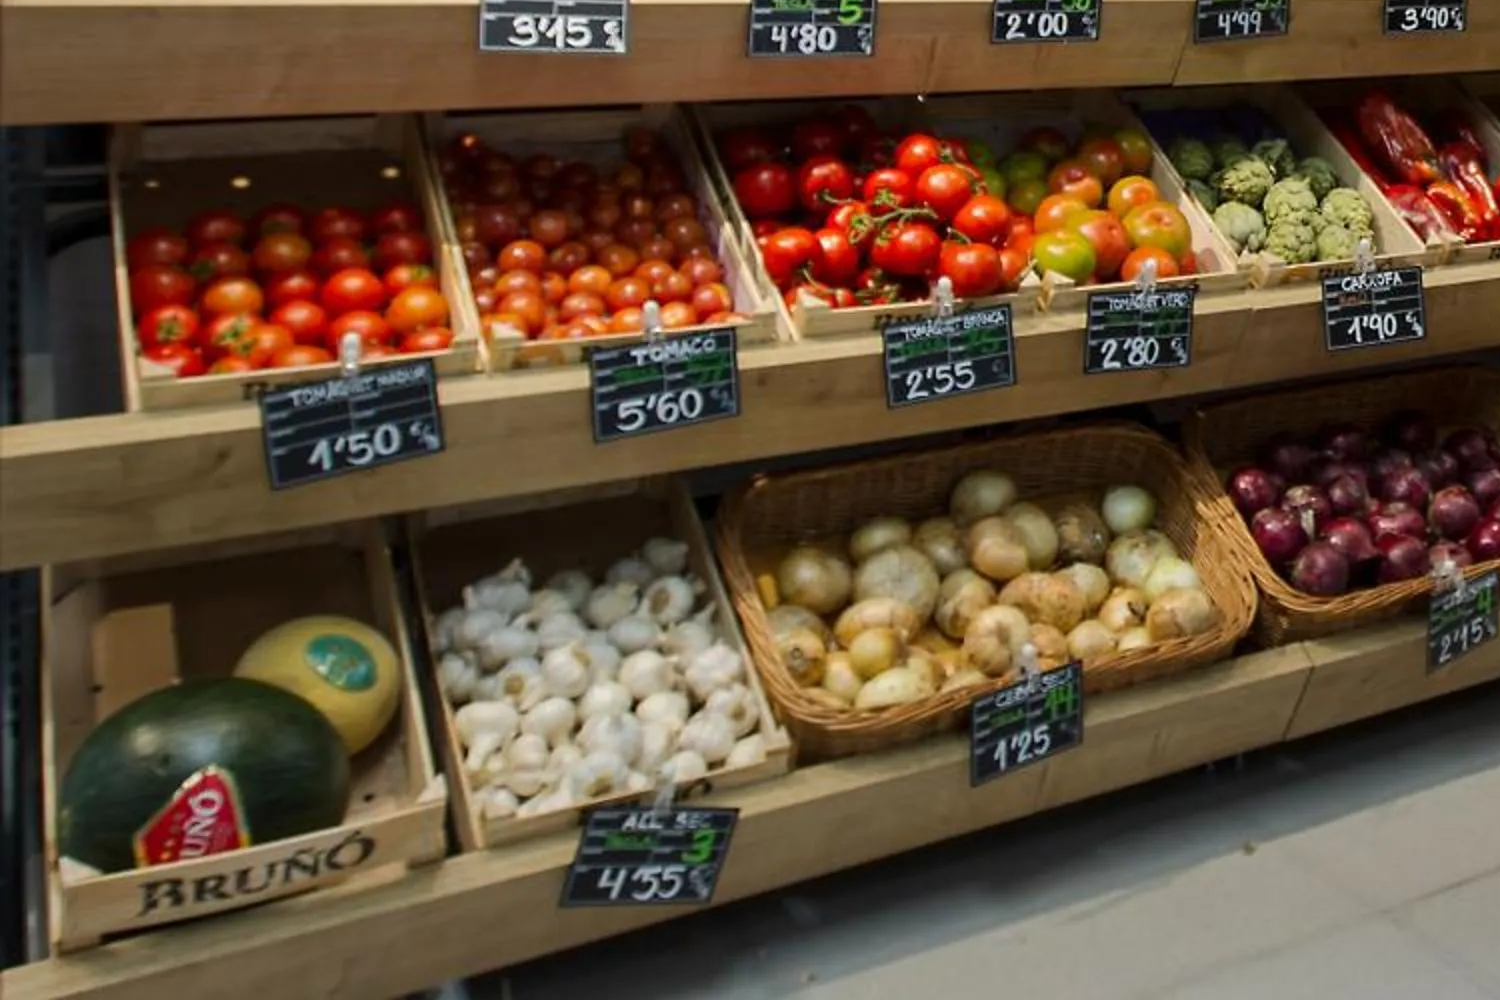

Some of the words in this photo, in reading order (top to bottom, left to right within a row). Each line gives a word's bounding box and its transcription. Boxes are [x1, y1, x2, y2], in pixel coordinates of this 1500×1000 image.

[507, 13, 593, 49] 3'15
[1005, 12, 1069, 40] 2'00
[1218, 10, 1262, 36] 4'99
[1401, 6, 1449, 31] 3'90
[771, 23, 838, 54] 4'80
[1347, 313, 1397, 343] 1'90
[1101, 336, 1159, 368] 2'80
[906, 360, 975, 400] 2'55
[616, 388, 704, 432] 5'60
[308, 422, 401, 471] 1'50
[1438, 616, 1485, 664] 2'15
[993, 724, 1051, 772] 1'25
[681, 828, 716, 863] 3
[136, 830, 376, 917] BRUÑÓ
[597, 864, 687, 900] 4'55
